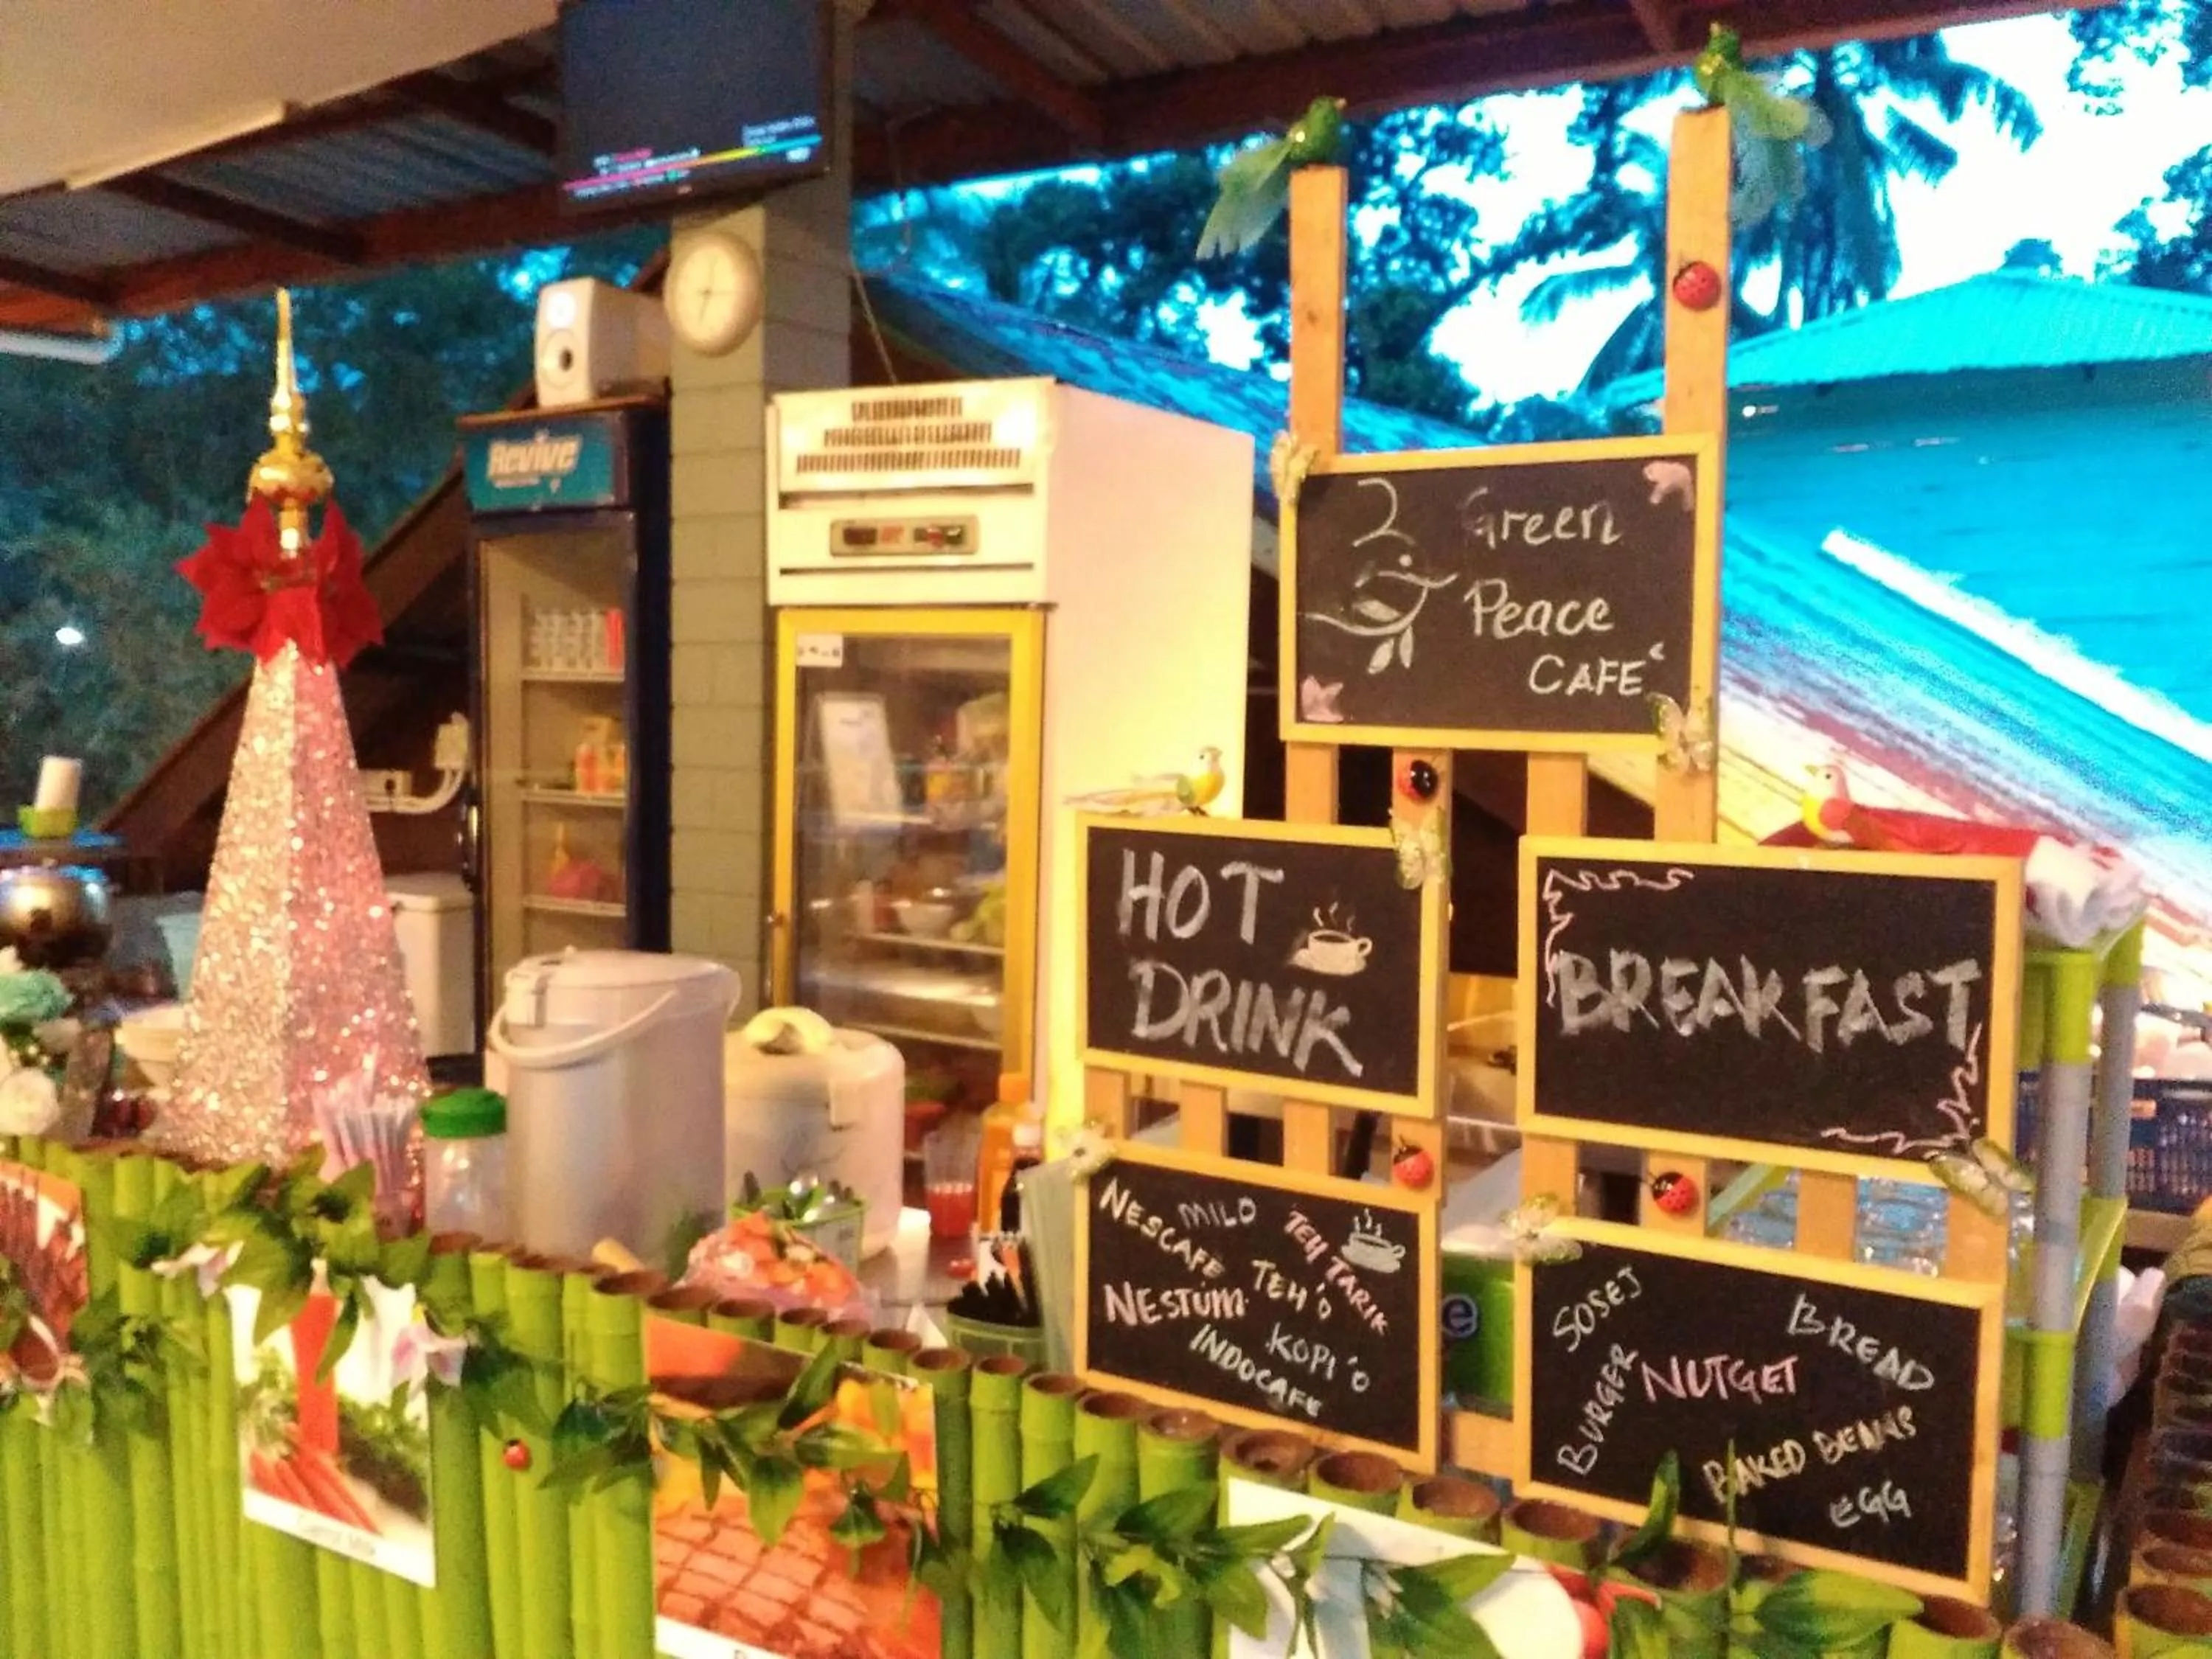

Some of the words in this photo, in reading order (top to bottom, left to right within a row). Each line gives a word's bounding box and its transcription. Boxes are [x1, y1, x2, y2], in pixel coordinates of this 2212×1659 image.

[1464, 578, 1614, 639] Peace
[1118, 848, 1284, 945] HOT
[1129, 959, 1363, 1078] DRINK
[1552, 948, 1983, 1054] BREAKFAST
[1099, 1178, 1225, 1279] NESCAFE
[1284, 1209, 1329, 1265] TEH
[1326, 1255, 1388, 1336] TARIK
[1553, 1266, 1642, 1352] SOSEJ
[1787, 1292, 1935, 1391] BREAD
[1188, 1324, 1324, 1419] INDOCAFE
[1557, 1343, 1639, 1475] BURGER
[1641, 1354, 1799, 1404] NUTGET
[1829, 1479, 1912, 1528] EGG
